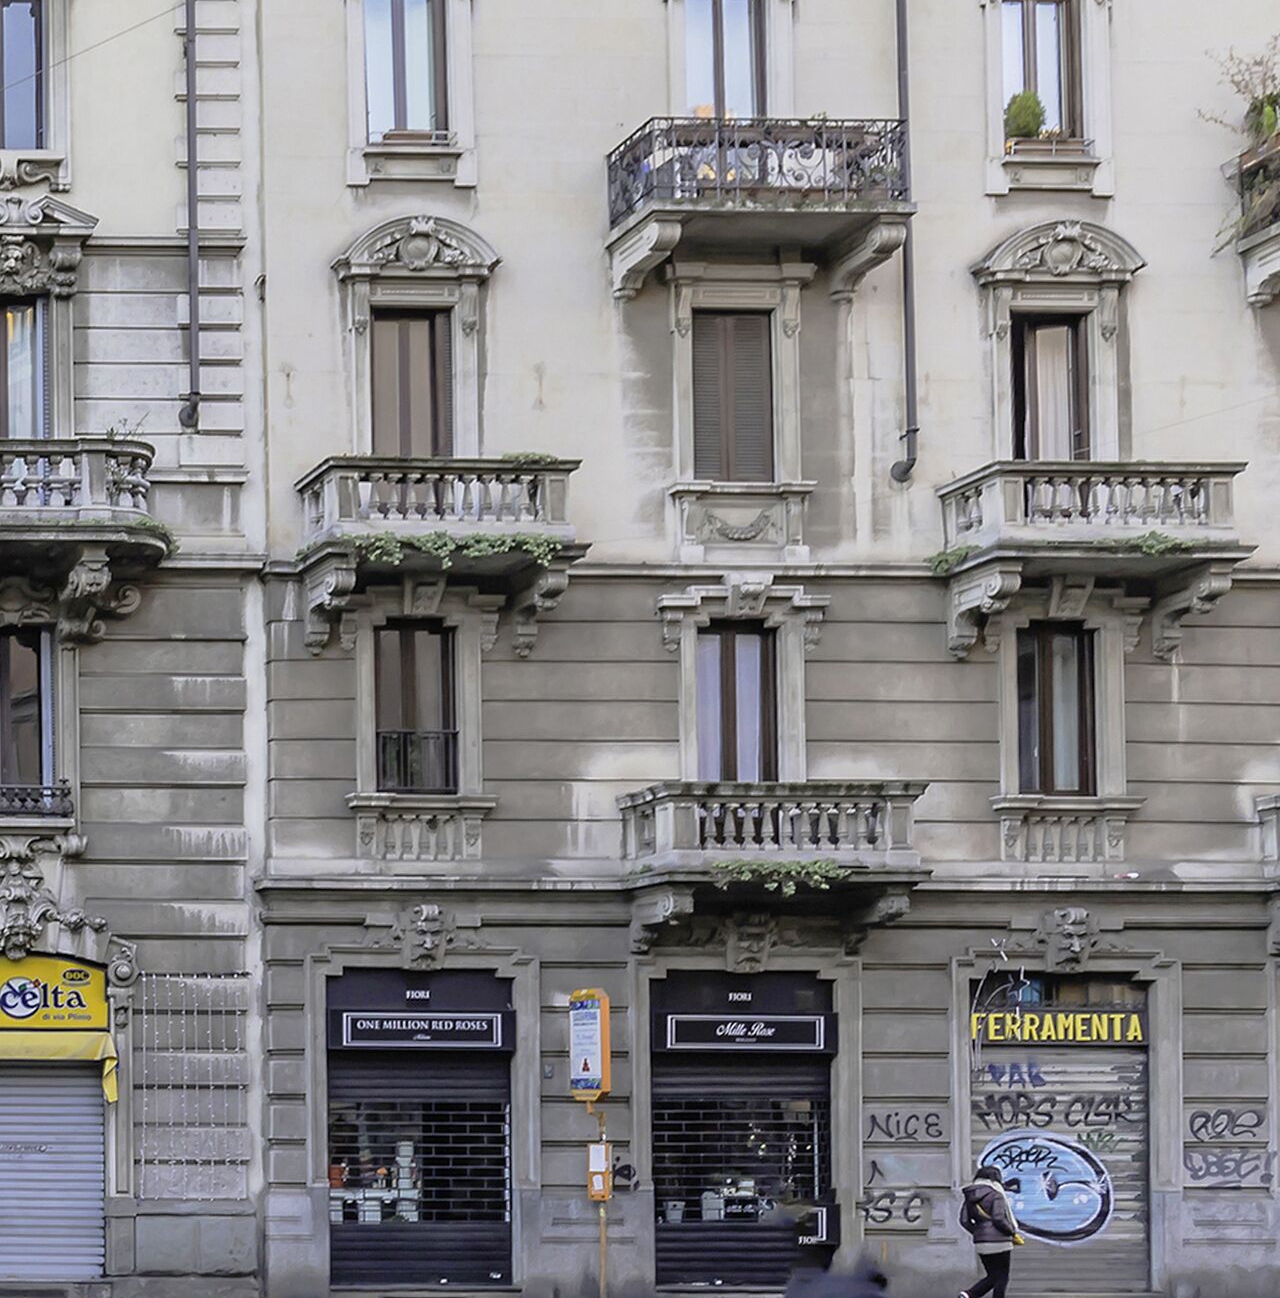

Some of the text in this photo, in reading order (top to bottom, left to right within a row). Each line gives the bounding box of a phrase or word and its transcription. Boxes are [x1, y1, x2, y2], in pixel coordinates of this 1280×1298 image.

[406, 990, 430, 999] FIORI
[357, 1020, 488, 1031] ONE MILLION RED ROSES
[716, 1022, 776, 1036] Mille Rose
[971, 1013, 1143, 1041] FERRAMENTA
